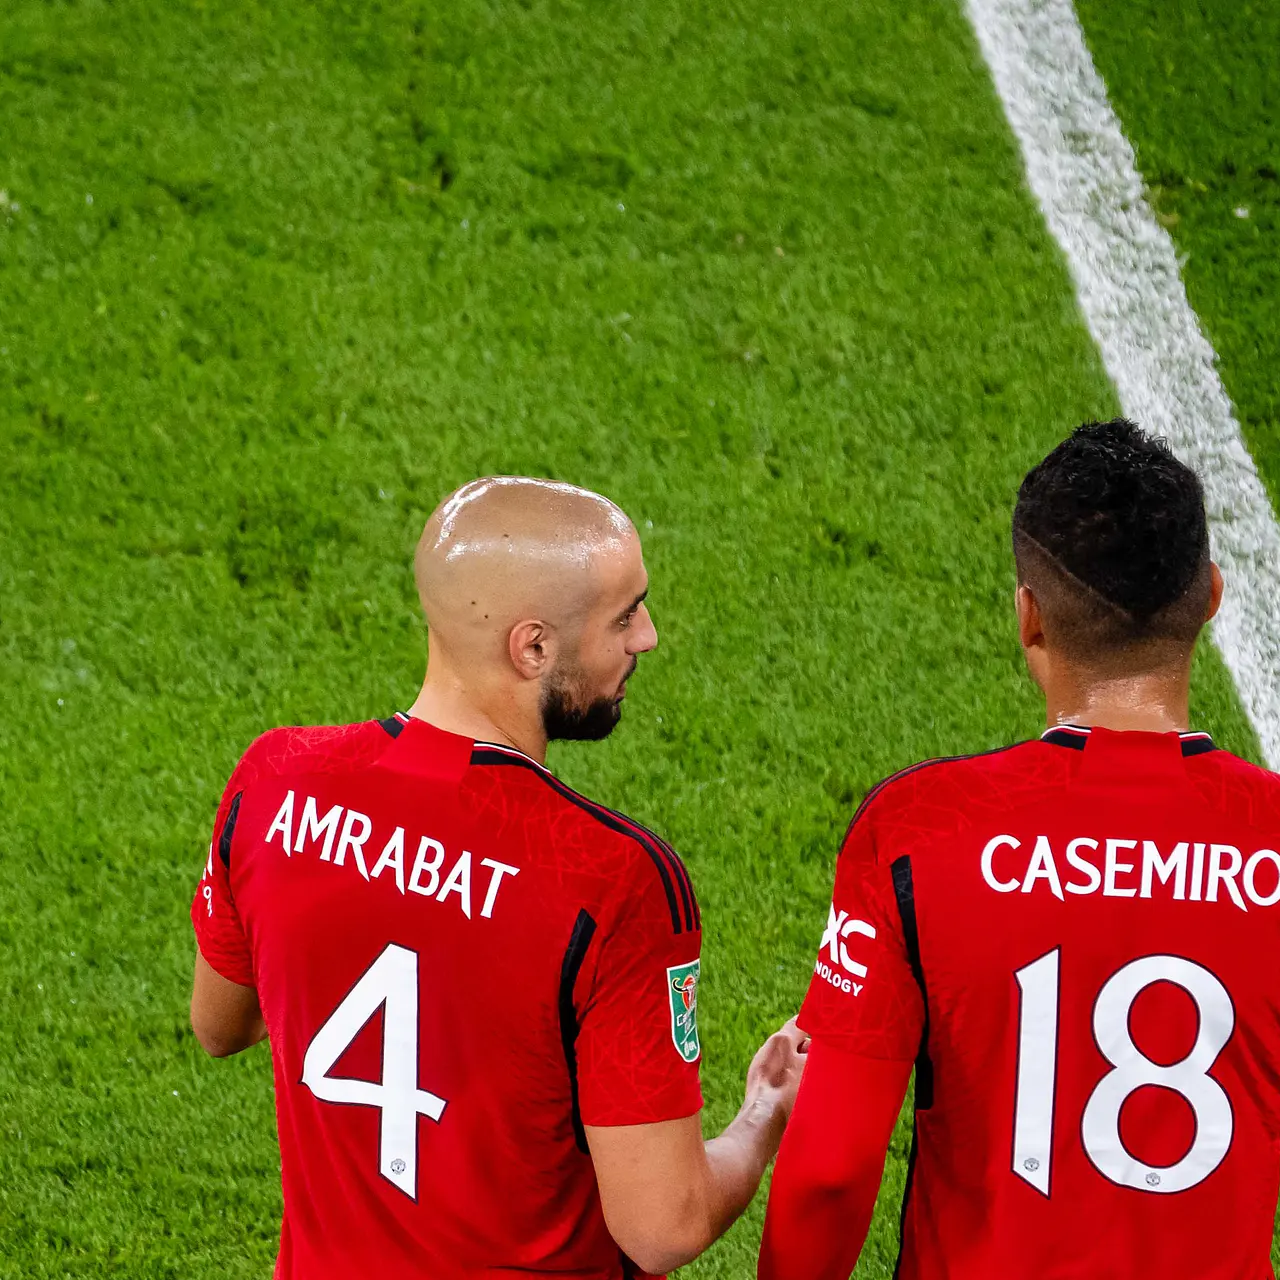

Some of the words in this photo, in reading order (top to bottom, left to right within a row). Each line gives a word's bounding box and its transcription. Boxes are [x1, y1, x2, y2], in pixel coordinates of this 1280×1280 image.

[264, 789, 521, 920] AMRABAT
[300, 941, 448, 1201] 4
[1010, 947, 1236, 1197] 18
